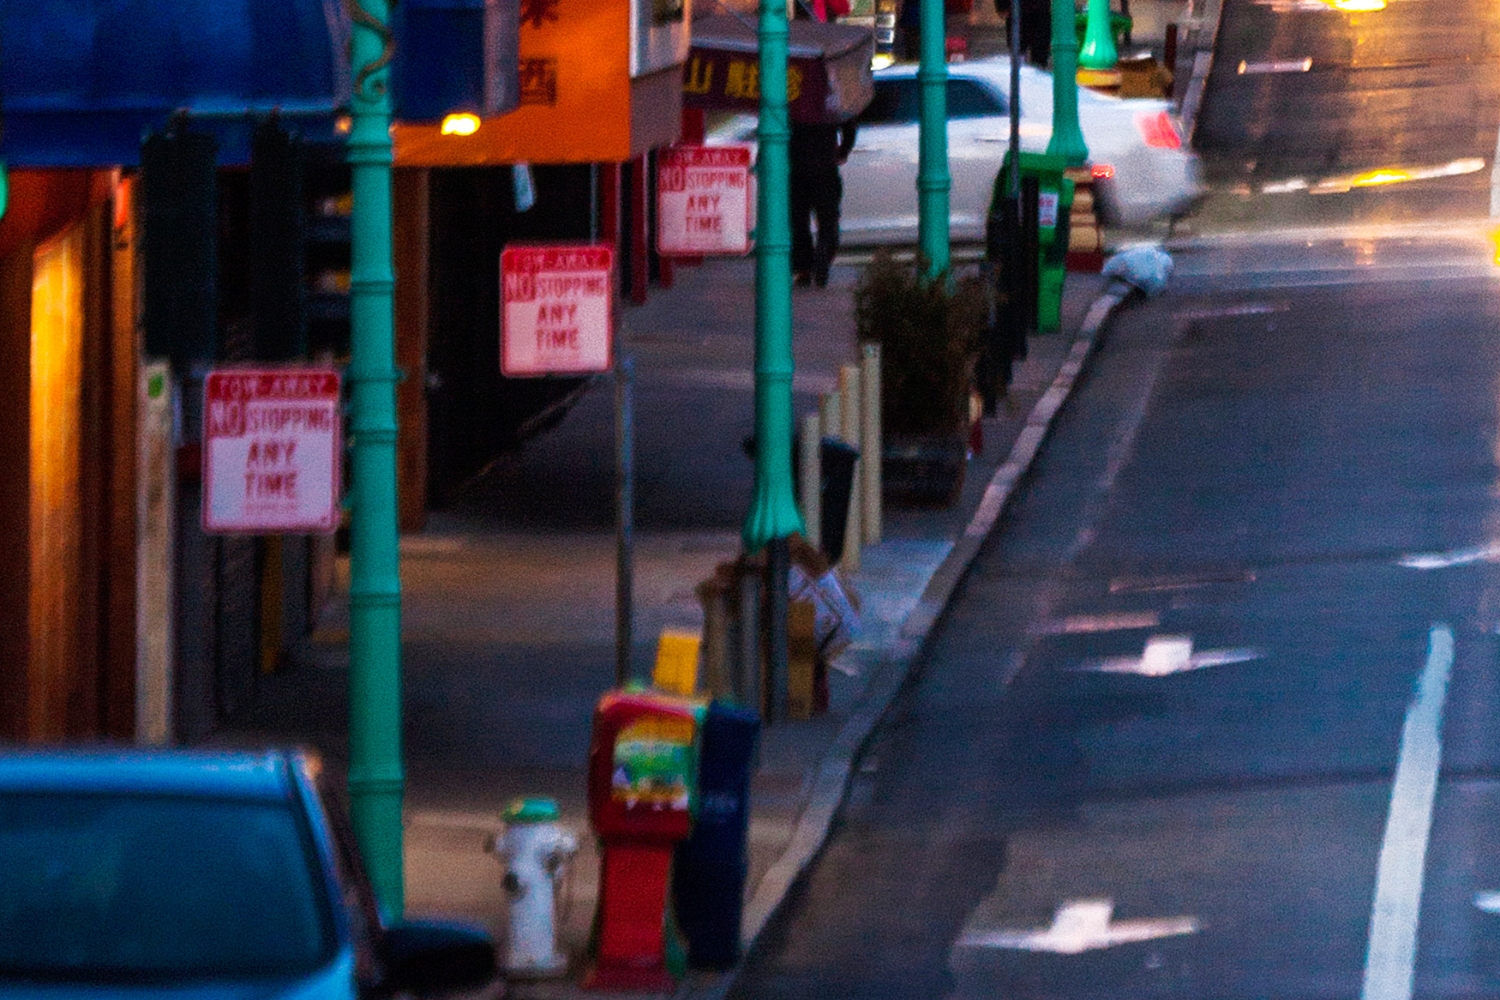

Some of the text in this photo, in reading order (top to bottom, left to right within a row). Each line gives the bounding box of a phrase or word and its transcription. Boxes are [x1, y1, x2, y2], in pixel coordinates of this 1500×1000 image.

[684, 195, 721, 212] ANY
[684, 216, 722, 233] TIME
[537, 304, 578, 324] ANY
[536, 329, 579, 351] TIME
[210, 402, 331, 435] NO STOPPING
[246, 441, 298, 468] ANY
[245, 470, 298, 500] TIME
